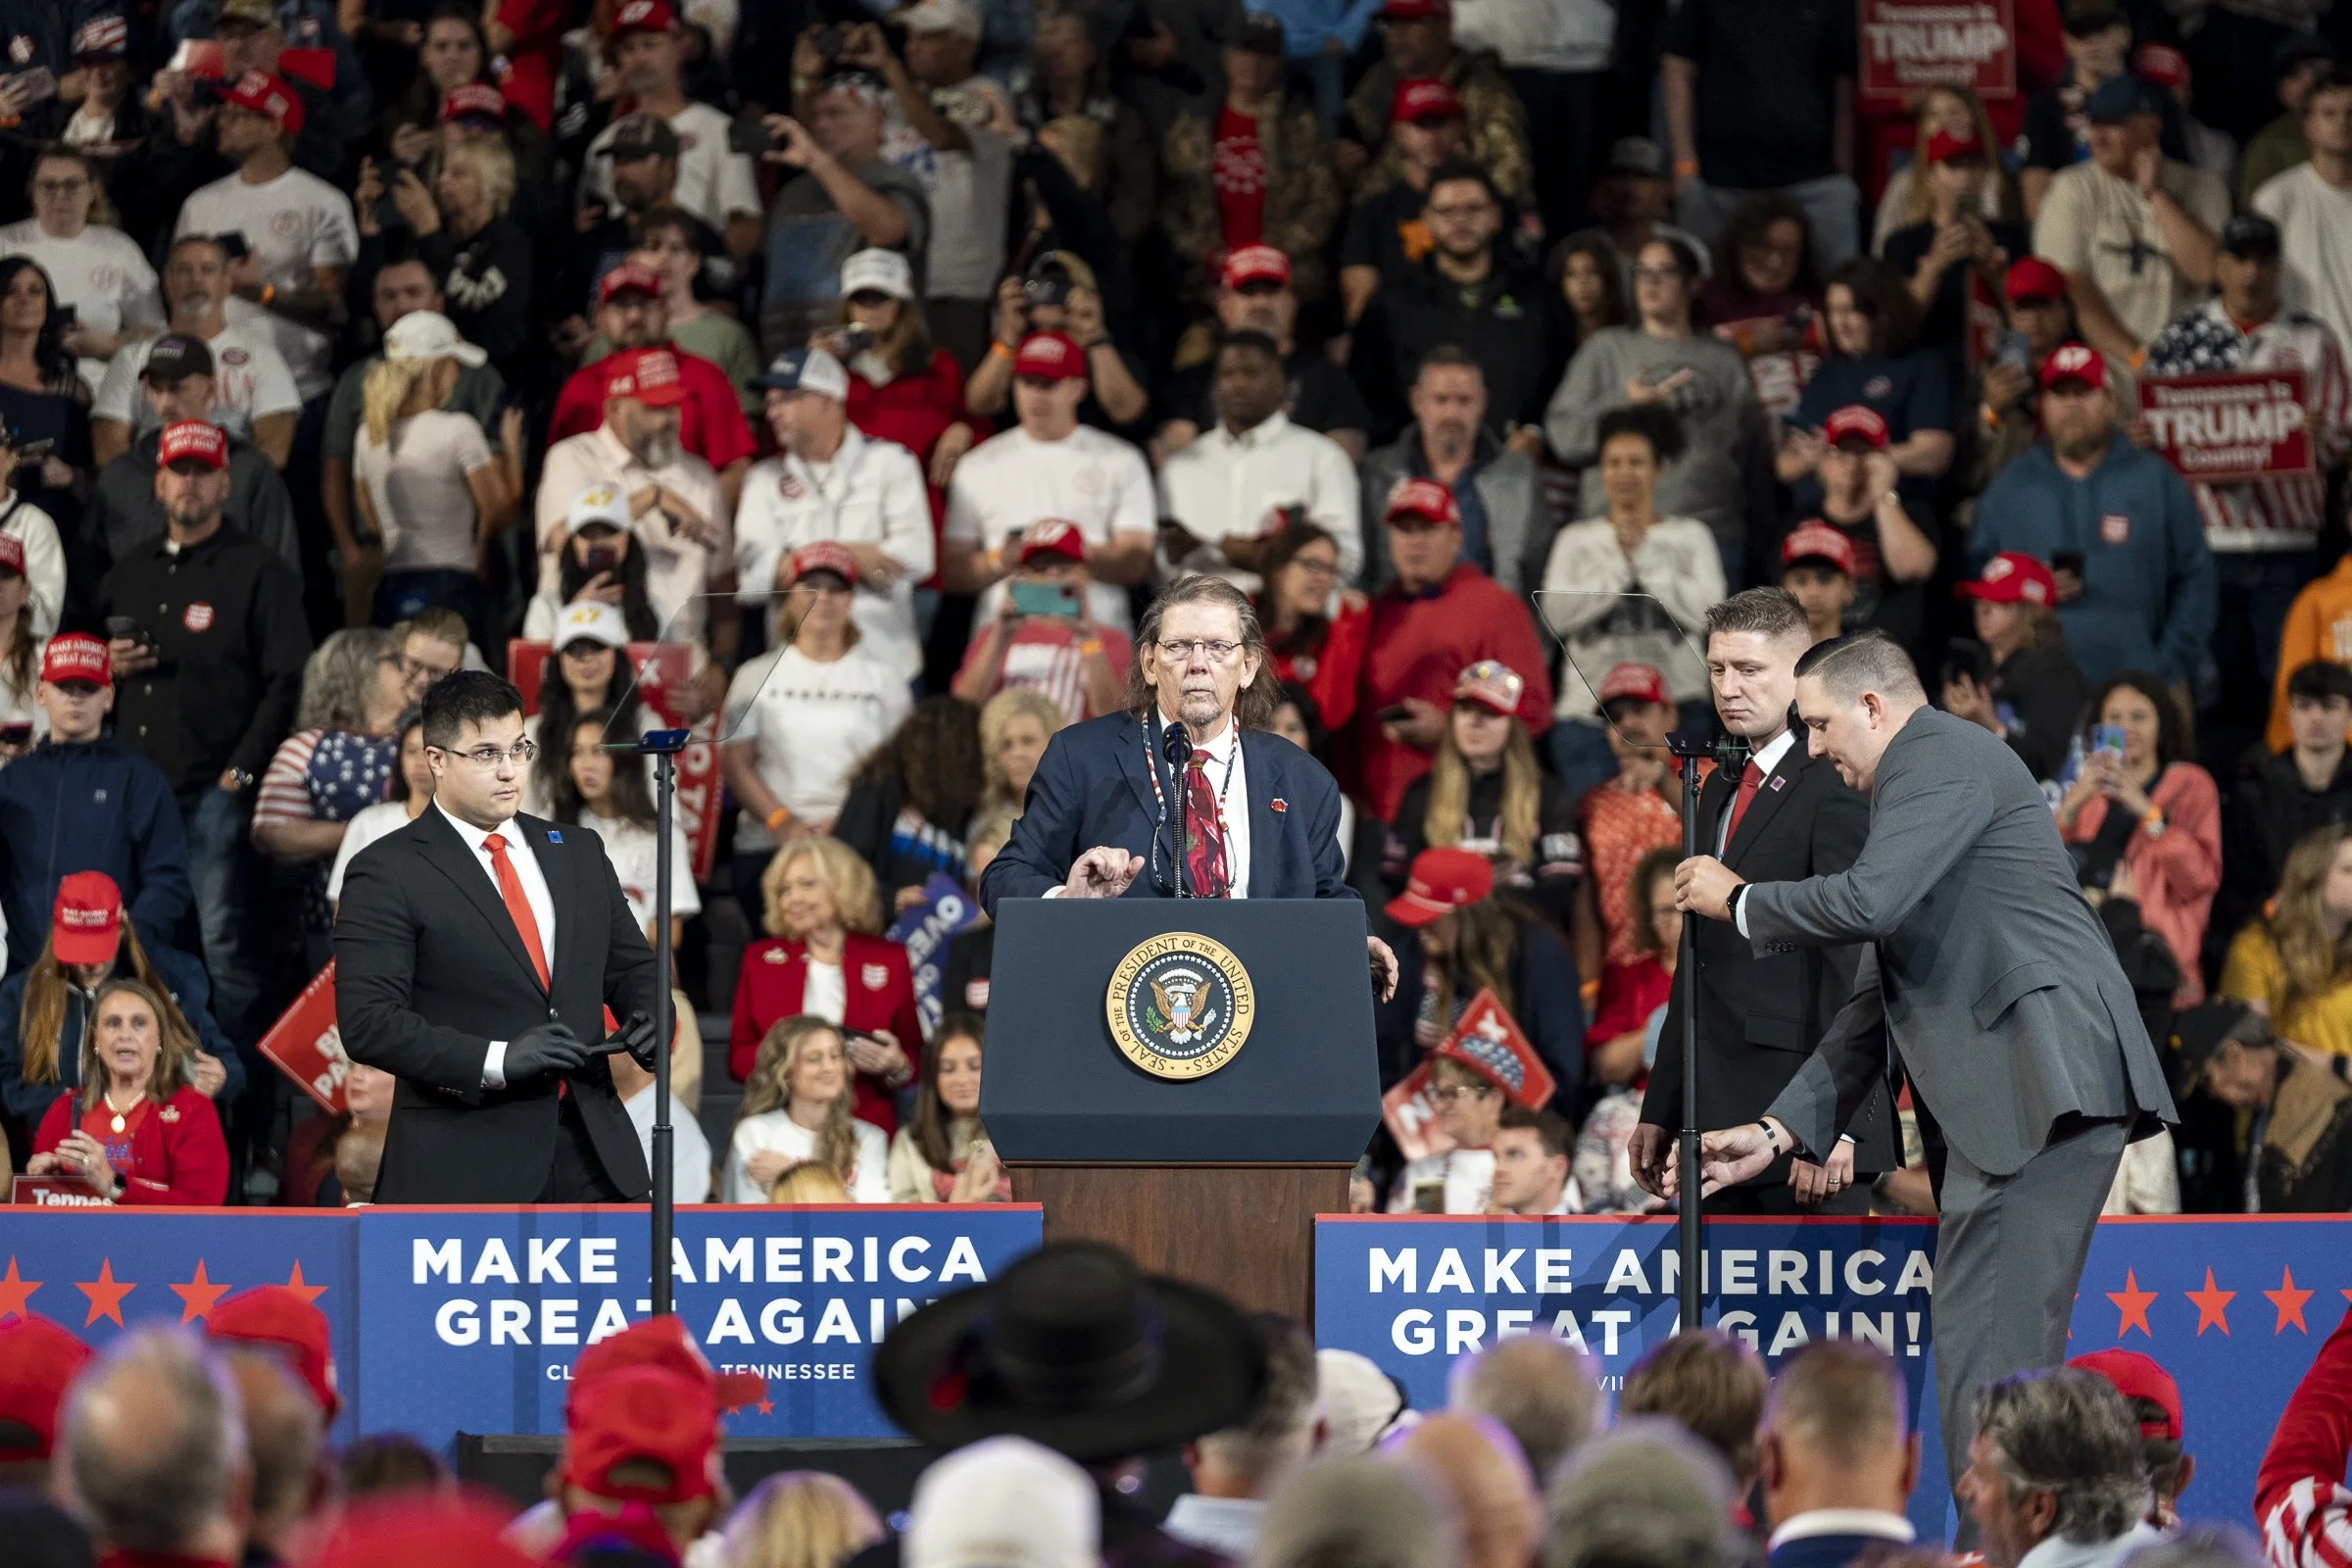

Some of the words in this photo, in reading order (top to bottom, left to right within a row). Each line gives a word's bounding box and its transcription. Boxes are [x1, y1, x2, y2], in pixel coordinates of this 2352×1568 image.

[1864, 23, 2008, 63] TRUMP
[2145, 402, 2305, 449] TRUMP
[570, 608, 602, 624] 47
[49, 640, 73, 656] MAKE
[1182, 939, 1196, 948] OF
[1199, 943, 1217, 956] THE
[1112, 938, 1178, 1001] PRESIDENT
[1219, 956, 1250, 1014] UNITED
[1114, 1006, 1125, 1026] THE
[1119, 1029, 1130, 1042] OF
[1130, 1041, 1166, 1071] SEAL
[1193, 1028, 1243, 1072] STATES
[413, 1238, 617, 1284] MAKE
[1369, 1248, 1572, 1294] MAKE
[1668, 1310, 1921, 1356] GAIN!
